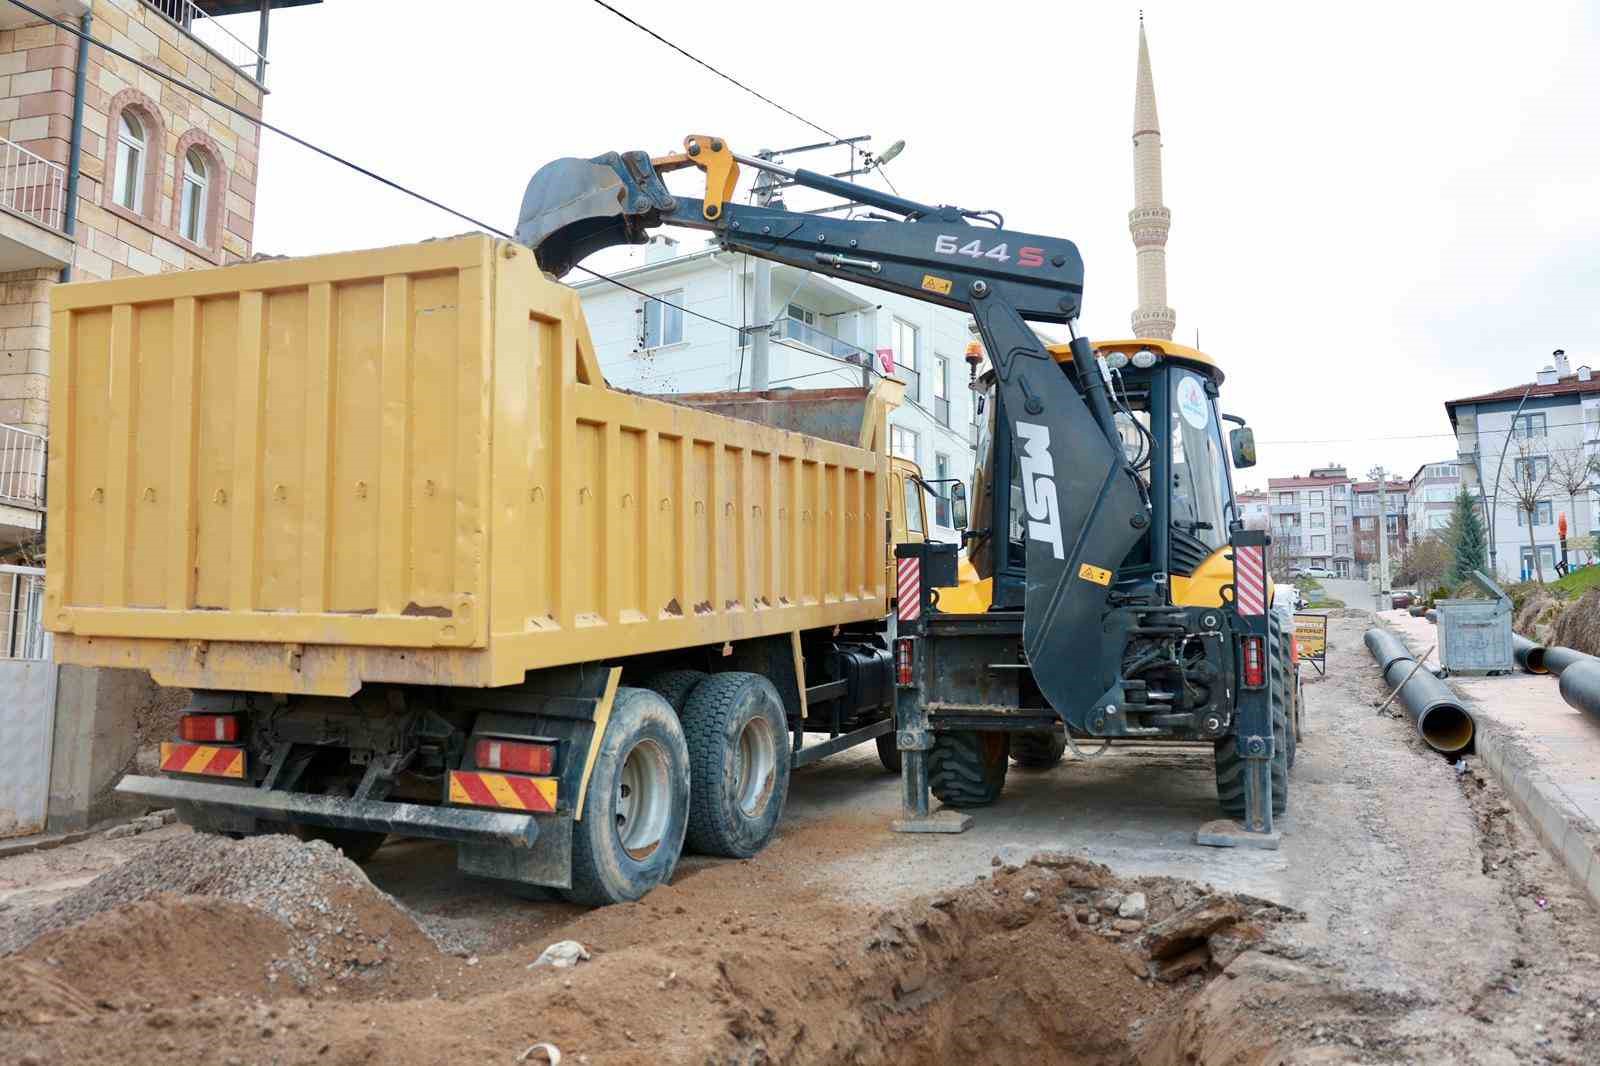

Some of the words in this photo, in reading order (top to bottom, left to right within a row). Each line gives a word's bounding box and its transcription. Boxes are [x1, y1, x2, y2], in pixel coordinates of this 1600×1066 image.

[934, 235, 1011, 262] 644
[1017, 246, 1047, 268] S
[1016, 421, 1065, 560] MST
